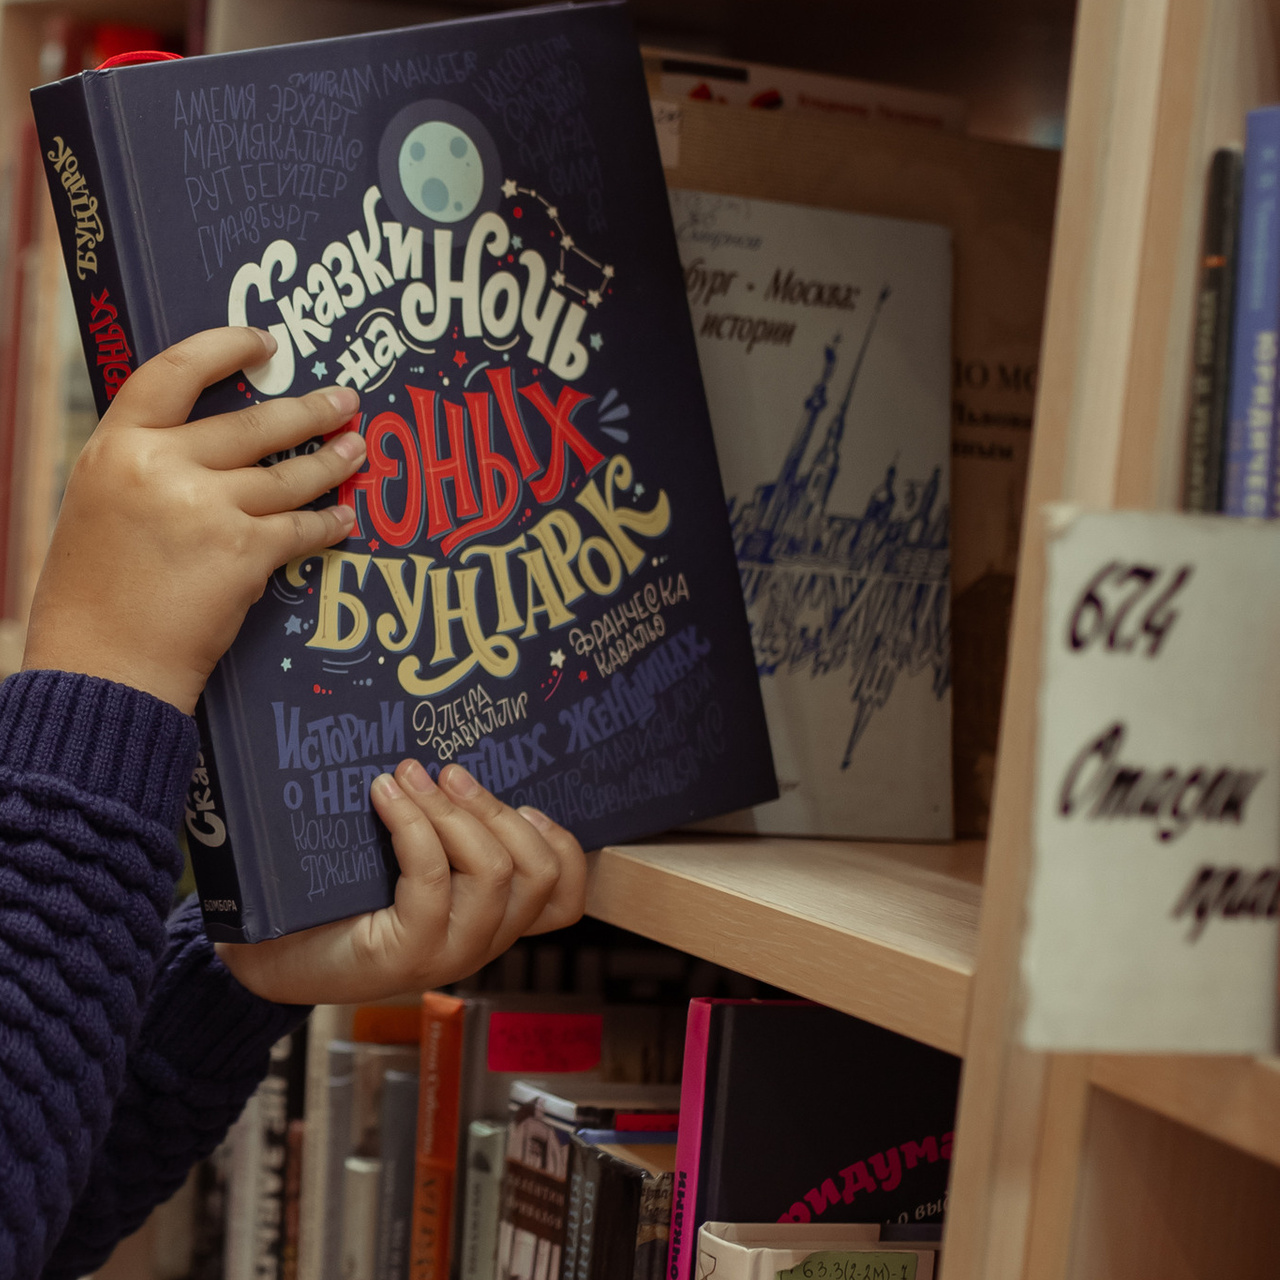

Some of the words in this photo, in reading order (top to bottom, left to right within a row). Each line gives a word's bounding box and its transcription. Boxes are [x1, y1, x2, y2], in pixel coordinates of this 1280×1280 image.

[174, 84, 257, 129] АМЕЛИЯ
[267, 84, 359, 136] ЭРХАРТ
[47, 135, 105, 281] БУНТАРОК
[184, 166, 234, 222] РУТ
[240, 161, 348, 201] БЕЙДЕР
[197, 203, 321, 281] ГИНЗБУРГ
[323, 365, 607, 557] ЮНЫХ
[285, 454, 672, 697] БУНТАРОК
[569, 572, 691, 658] ФРАНЧЕСКА
[593, 616, 667, 679] КАВАЛЬО
[412, 683, 494, 747] ЭЛЕНА
[431, 691, 530, 761] ФАВИЛЛИ
[558, 625, 712, 756] ЖЕНЩИНАХ
[203, 899, 238, 913] БОМБОРА
